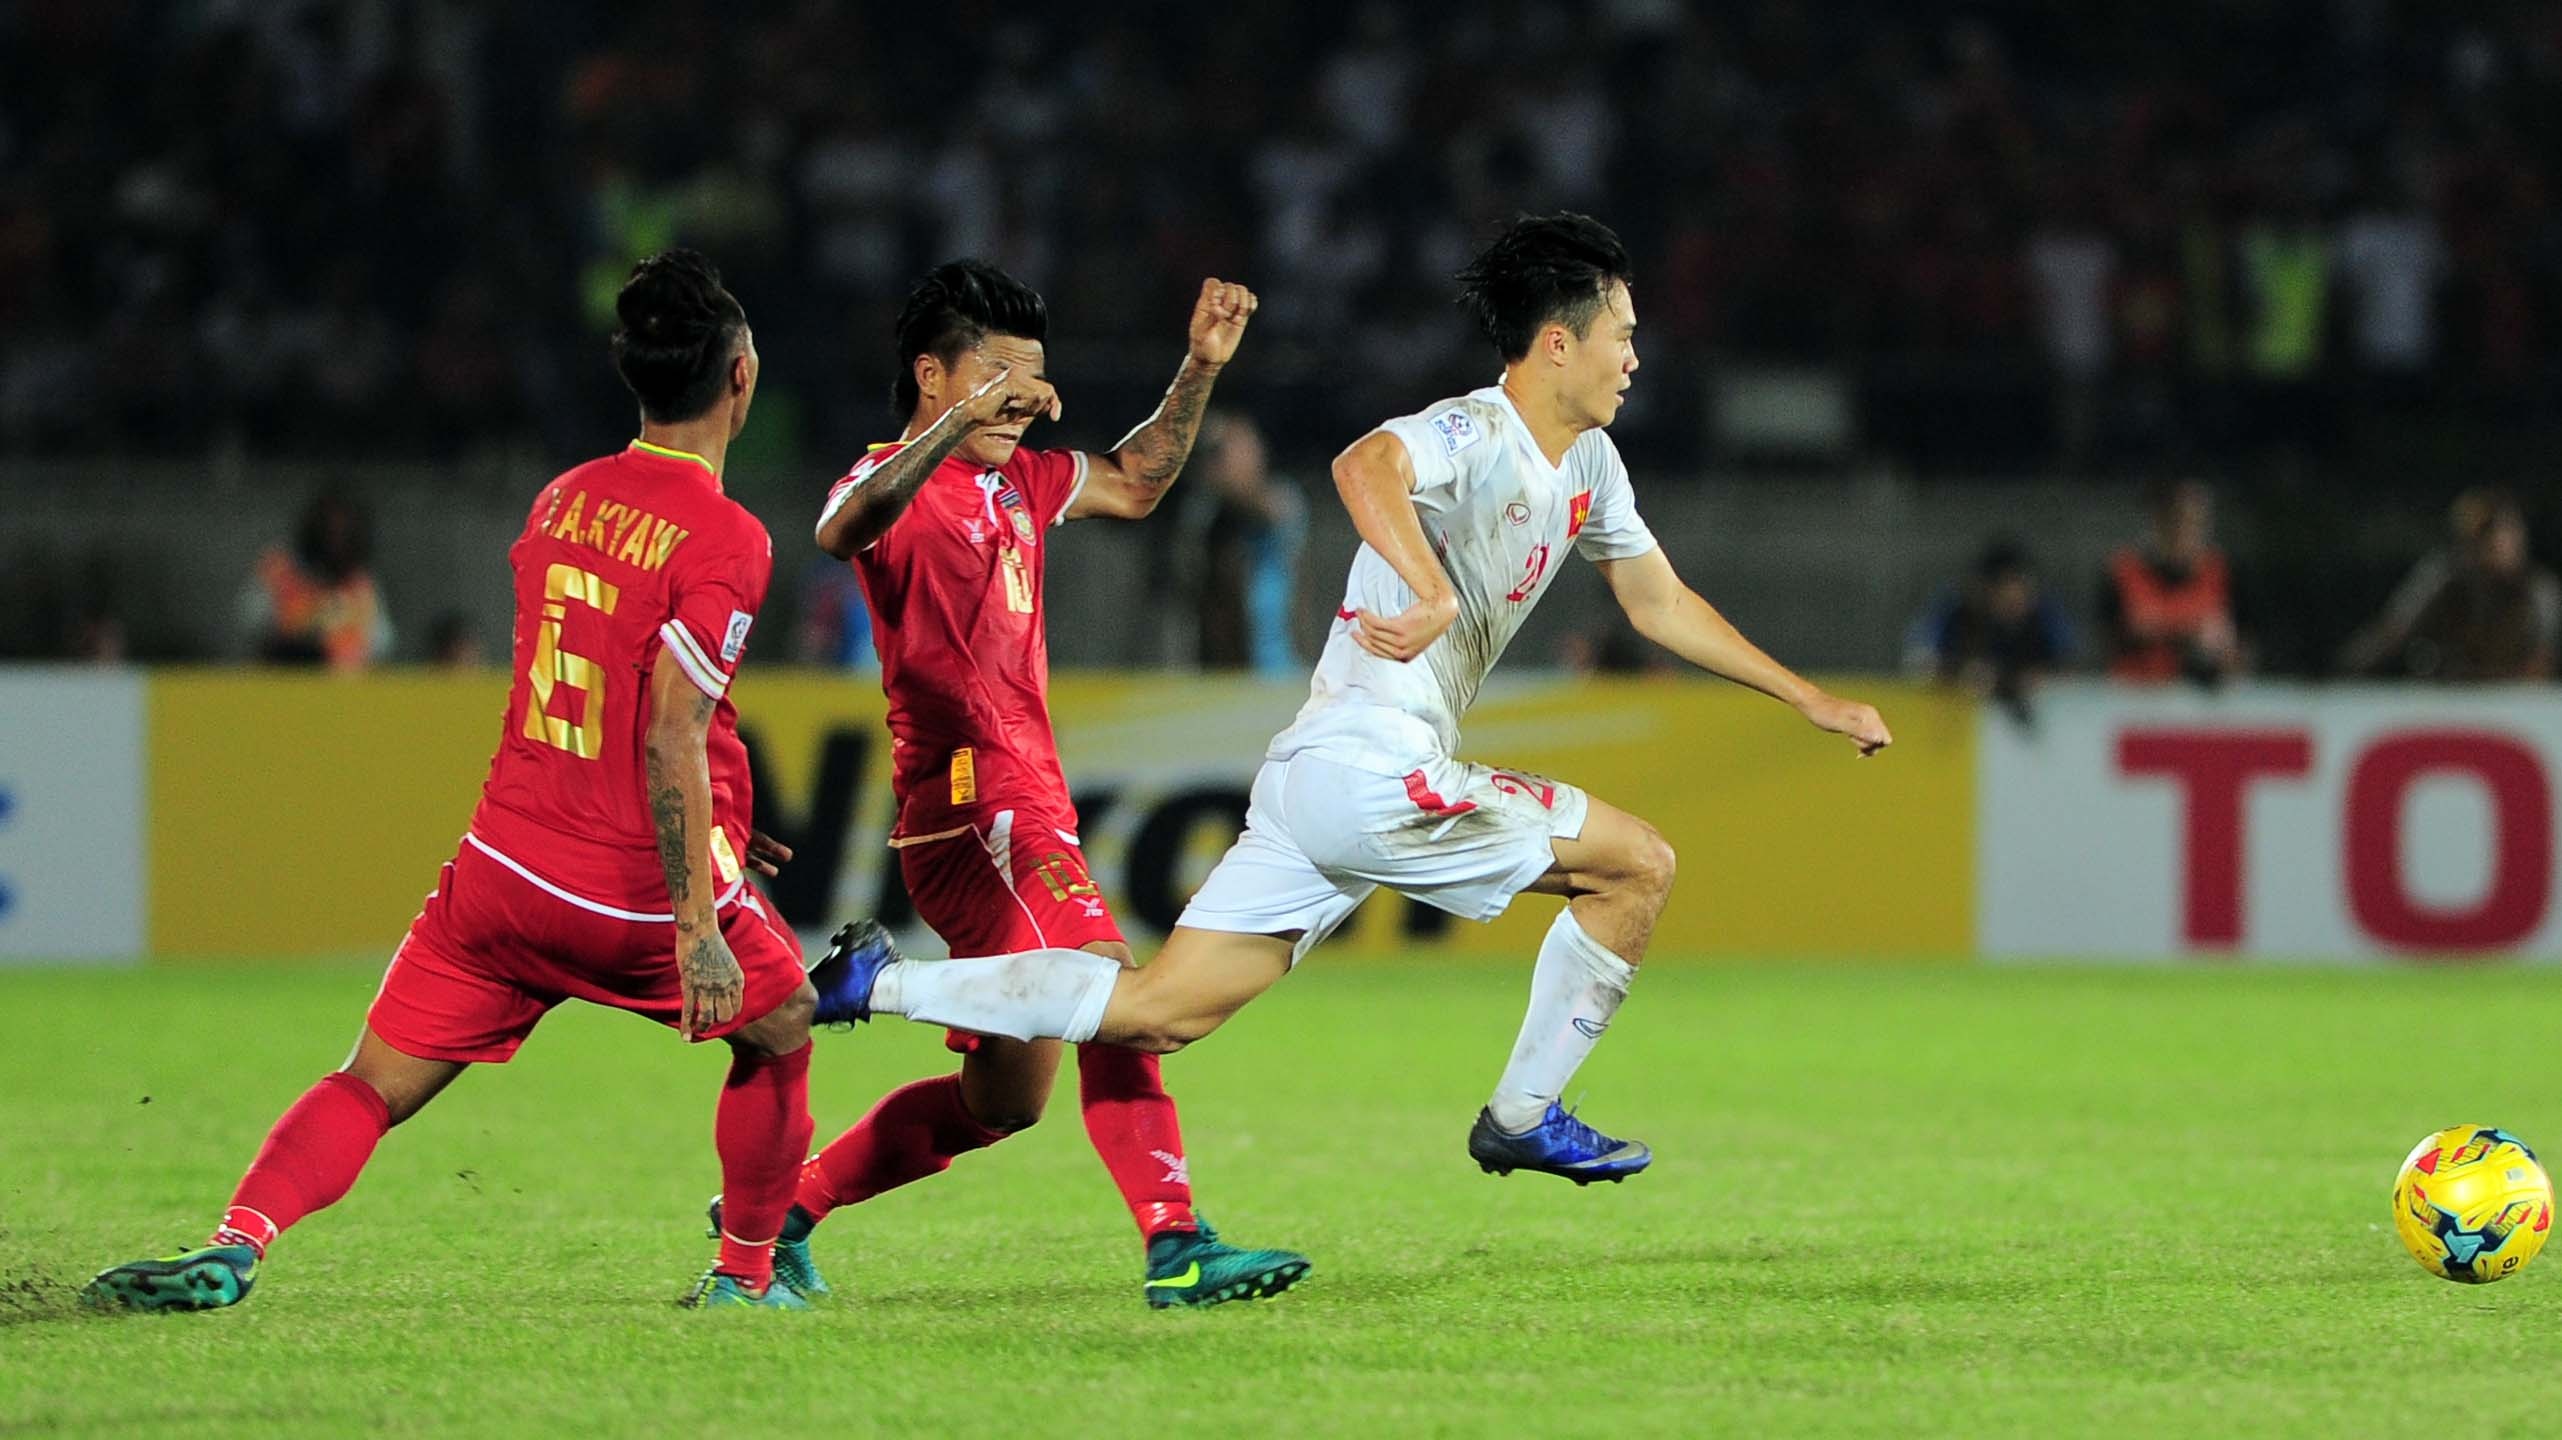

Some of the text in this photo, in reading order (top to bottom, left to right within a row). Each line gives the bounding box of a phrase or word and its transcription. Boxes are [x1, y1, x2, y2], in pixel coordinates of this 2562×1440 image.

[523, 562, 620, 760] 6
[1490, 766, 1555, 811] 2
[2113, 726, 2555, 957] TO
[1030, 852, 1099, 903] 10
